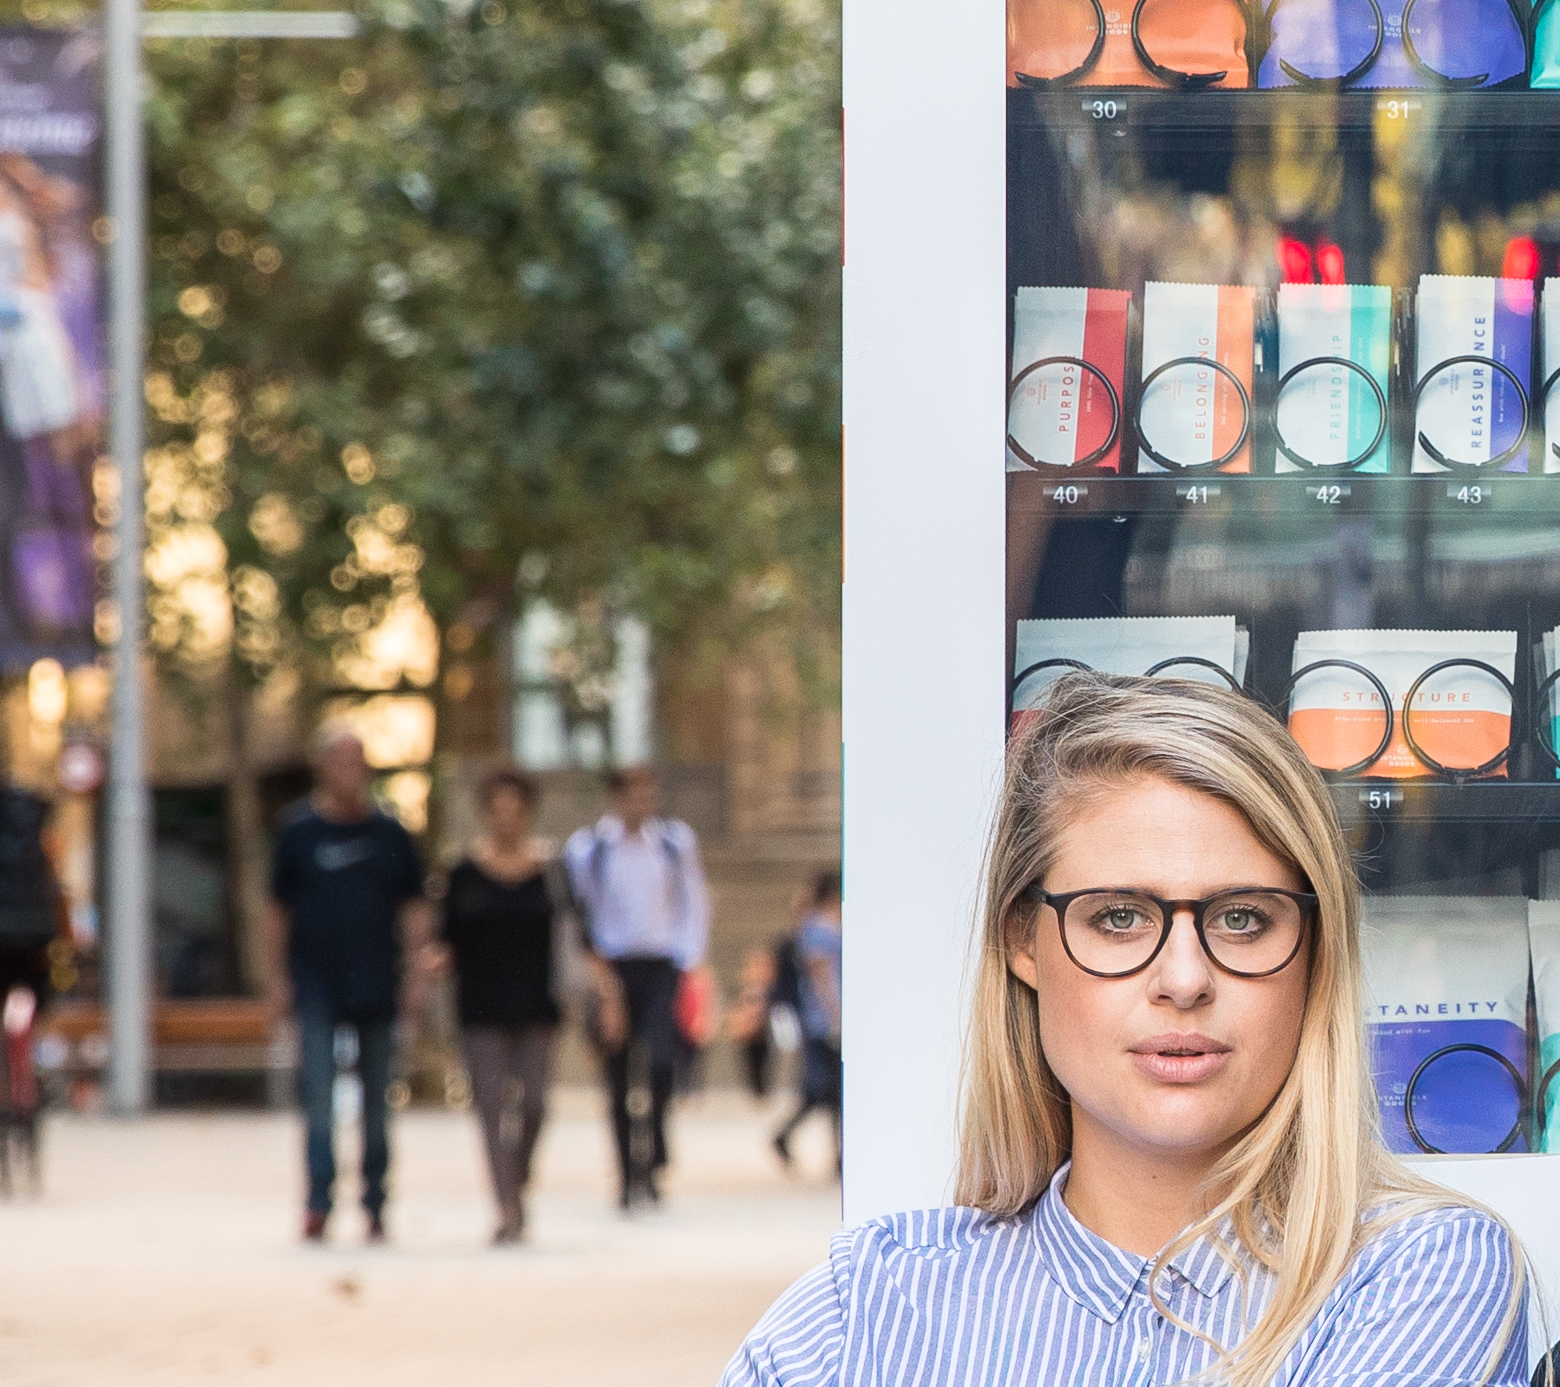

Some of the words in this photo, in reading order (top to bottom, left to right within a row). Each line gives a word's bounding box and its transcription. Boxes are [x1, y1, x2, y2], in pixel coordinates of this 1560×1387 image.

[1092, 100, 1117, 119] 30
[1387, 100, 1410, 119] 31
[1195, 336, 1210, 440] BELONGNG
[1471, 316, 1486, 449] REASSURNCE
[1058, 355, 1076, 432] PURPOS
[1053, 485, 1079, 504] 40
[1186, 485, 1208, 504] 41
[1316, 485, 1341, 504] 42
[1457, 485, 1482, 504] 43
[1369, 791, 1391, 809] 51
[1374, 1001, 1498, 1016] TANEITY
